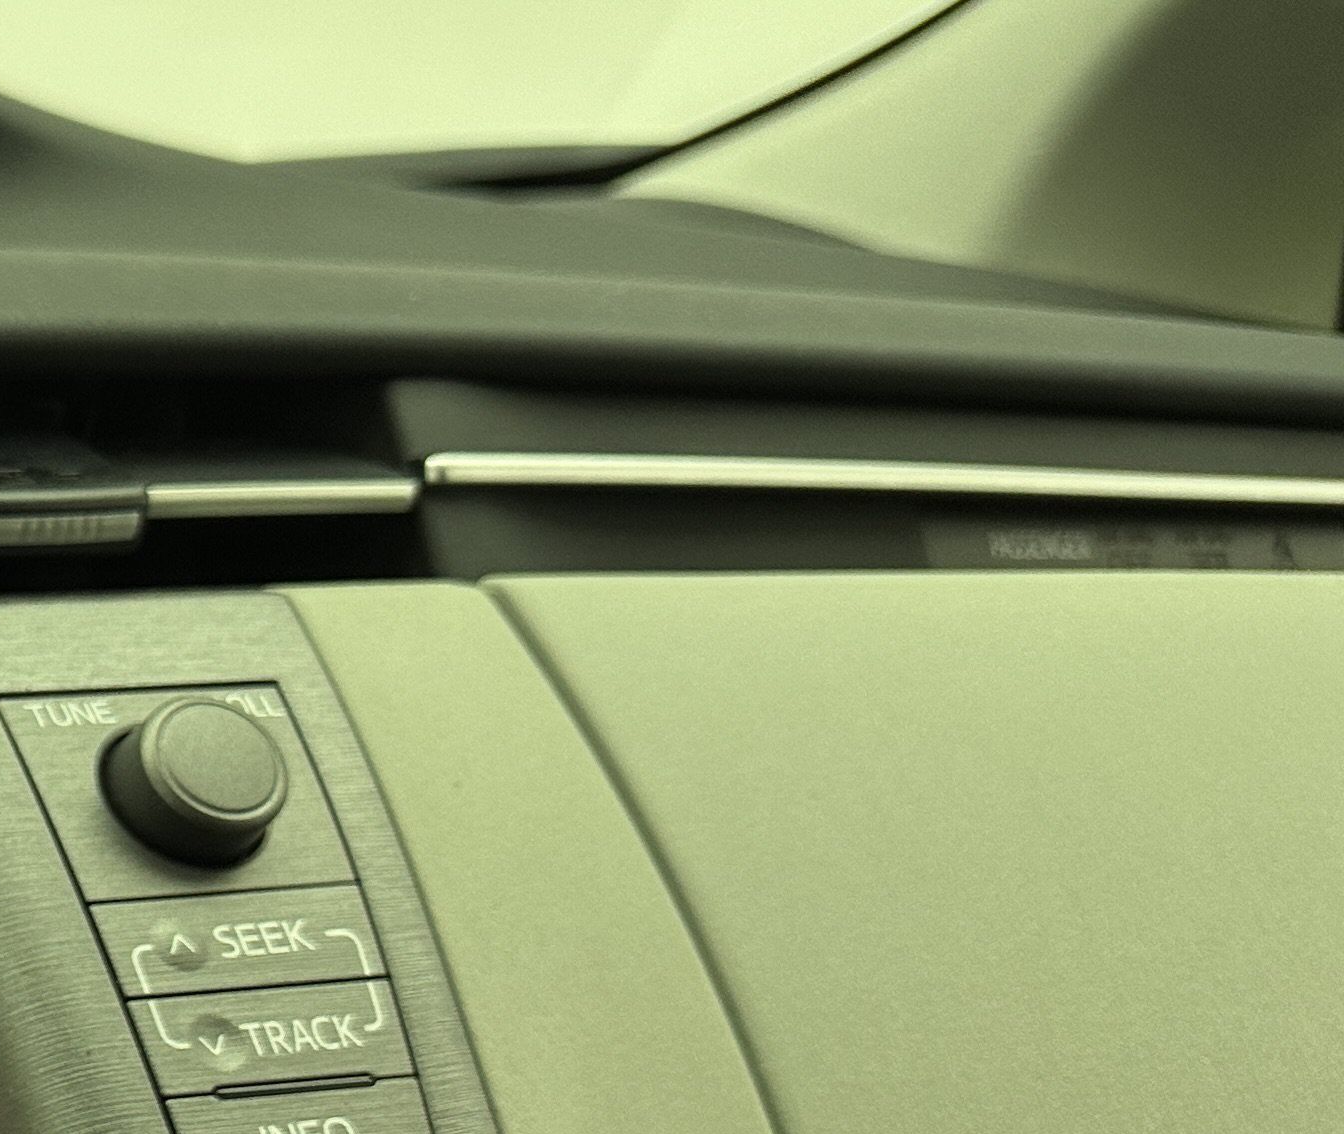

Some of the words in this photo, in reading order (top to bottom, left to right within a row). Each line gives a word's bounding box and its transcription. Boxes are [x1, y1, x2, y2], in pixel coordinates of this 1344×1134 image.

[23, 699, 117, 728] TUNE
[212, 918, 316, 959] SEEK
[238, 1013, 363, 1058] TRACK
